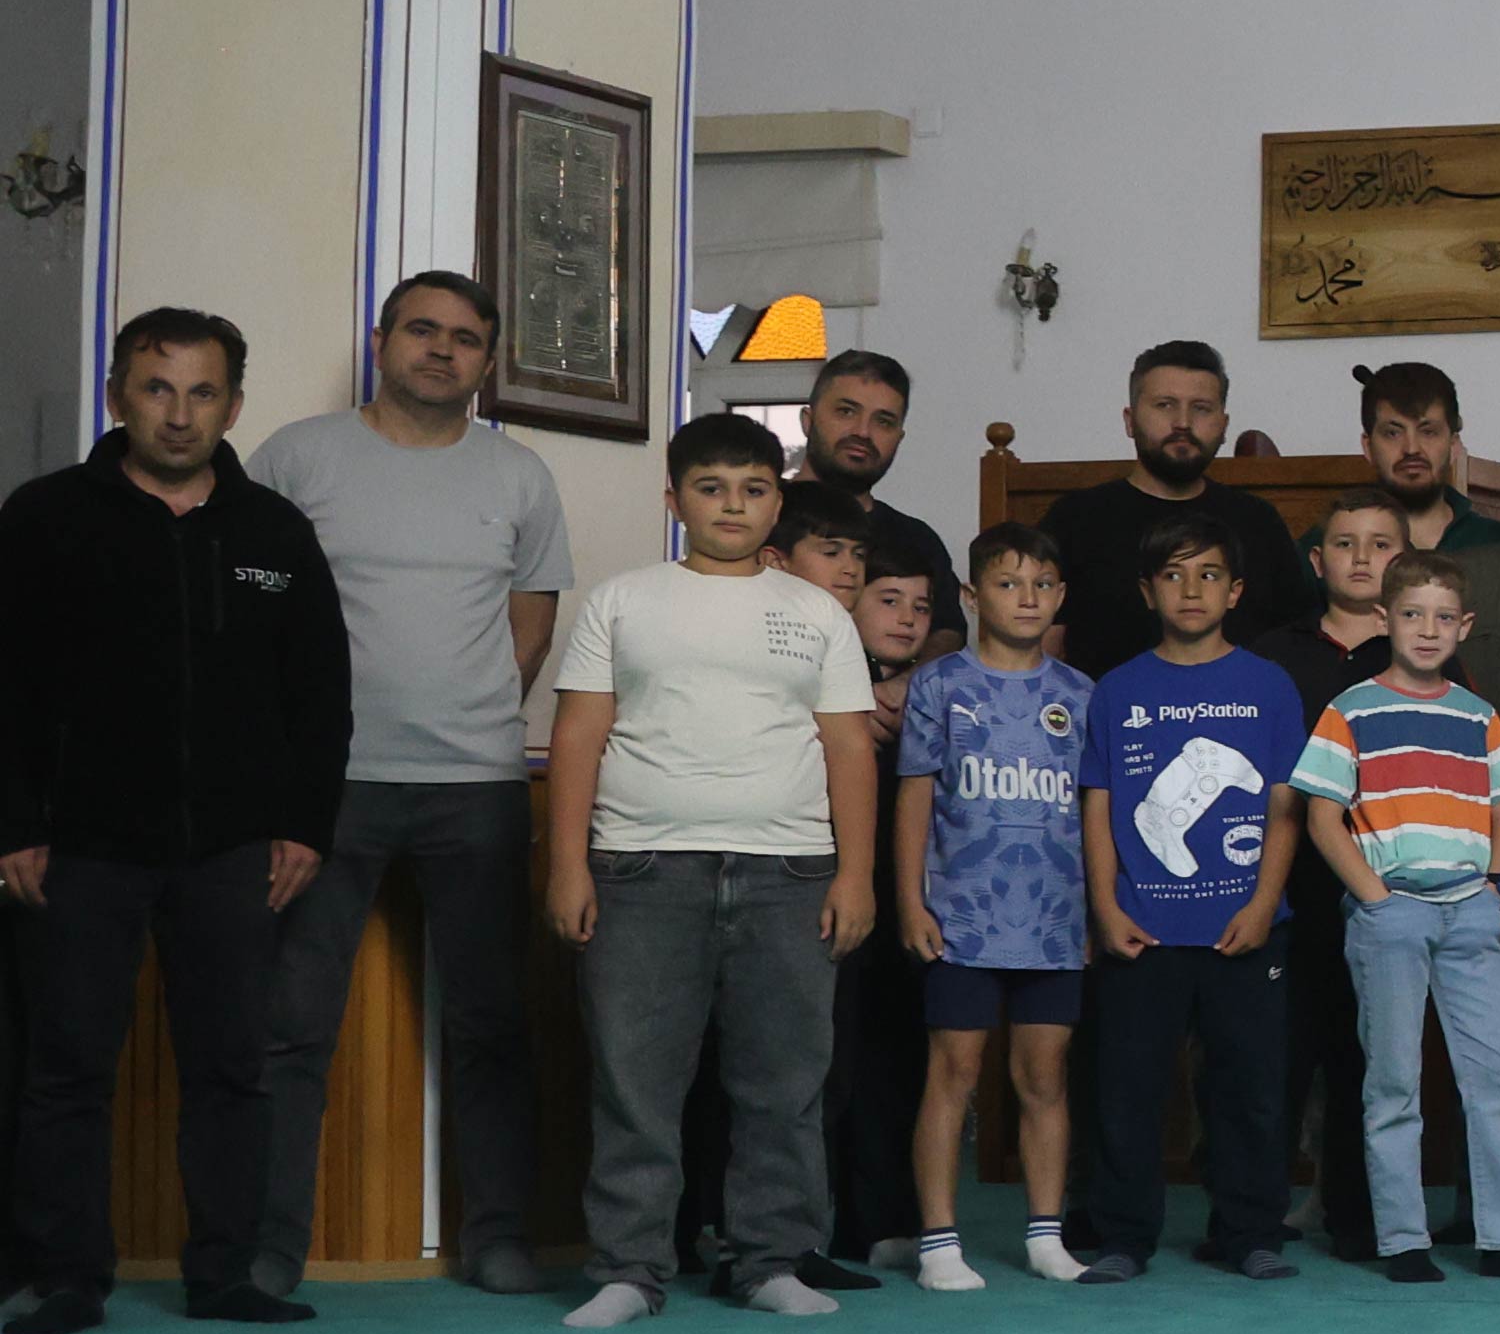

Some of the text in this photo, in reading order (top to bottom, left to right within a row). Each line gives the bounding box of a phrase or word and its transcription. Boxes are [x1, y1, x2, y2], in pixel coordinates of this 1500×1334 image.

[1159, 703, 1259, 723] PlayStation
[959, 754, 1073, 813] Otokoç
[1152, 892, 1189, 900] PLAYER
